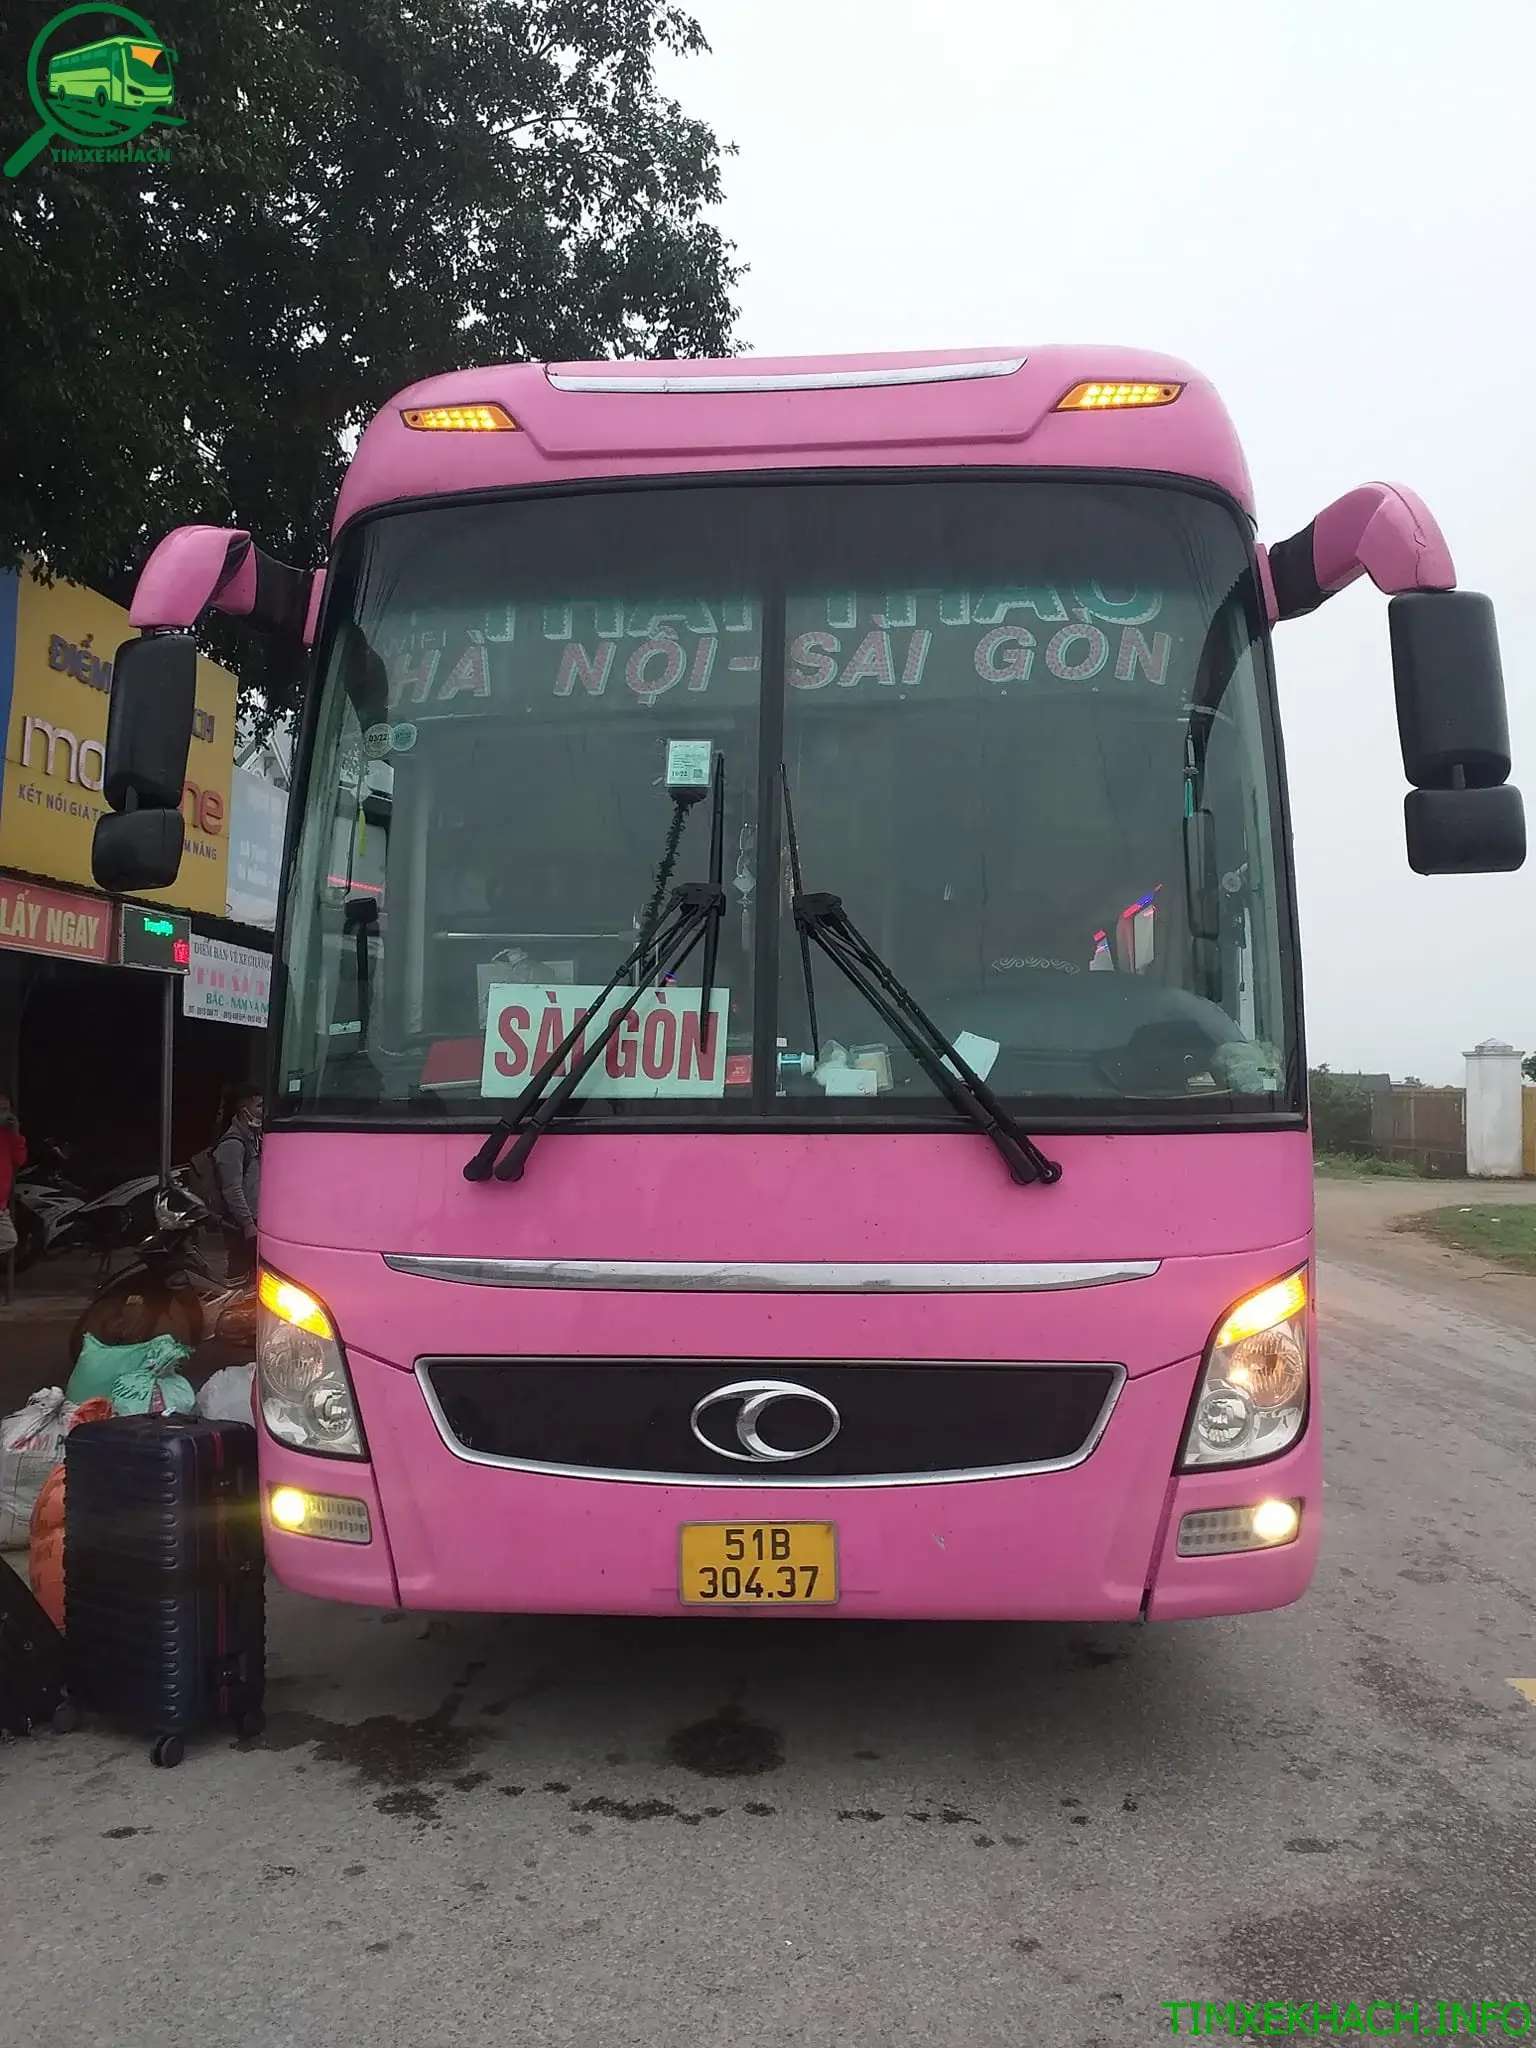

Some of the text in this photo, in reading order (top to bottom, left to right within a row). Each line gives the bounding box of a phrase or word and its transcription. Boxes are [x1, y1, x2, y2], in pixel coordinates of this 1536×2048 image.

[48, 632, 113, 695] ĐIỂM
[386, 625, 491, 708] HÀ
[787, 614, 933, 689] SÀI
[973, 607, 1172, 686] GÒN
[18, 782, 42, 805] KẾT
[46, 791, 67, 813] NỐI
[22, 714, 105, 793] mo
[177, 780, 224, 835] ne
[0, 888, 41, 941] LẤY
[45, 906, 100, 950] NGAY
[494, 990, 719, 1081] SÀI GÒN
[725, 1528, 791, 1561] 51B
[698, 1565, 819, 1599] 304.37
